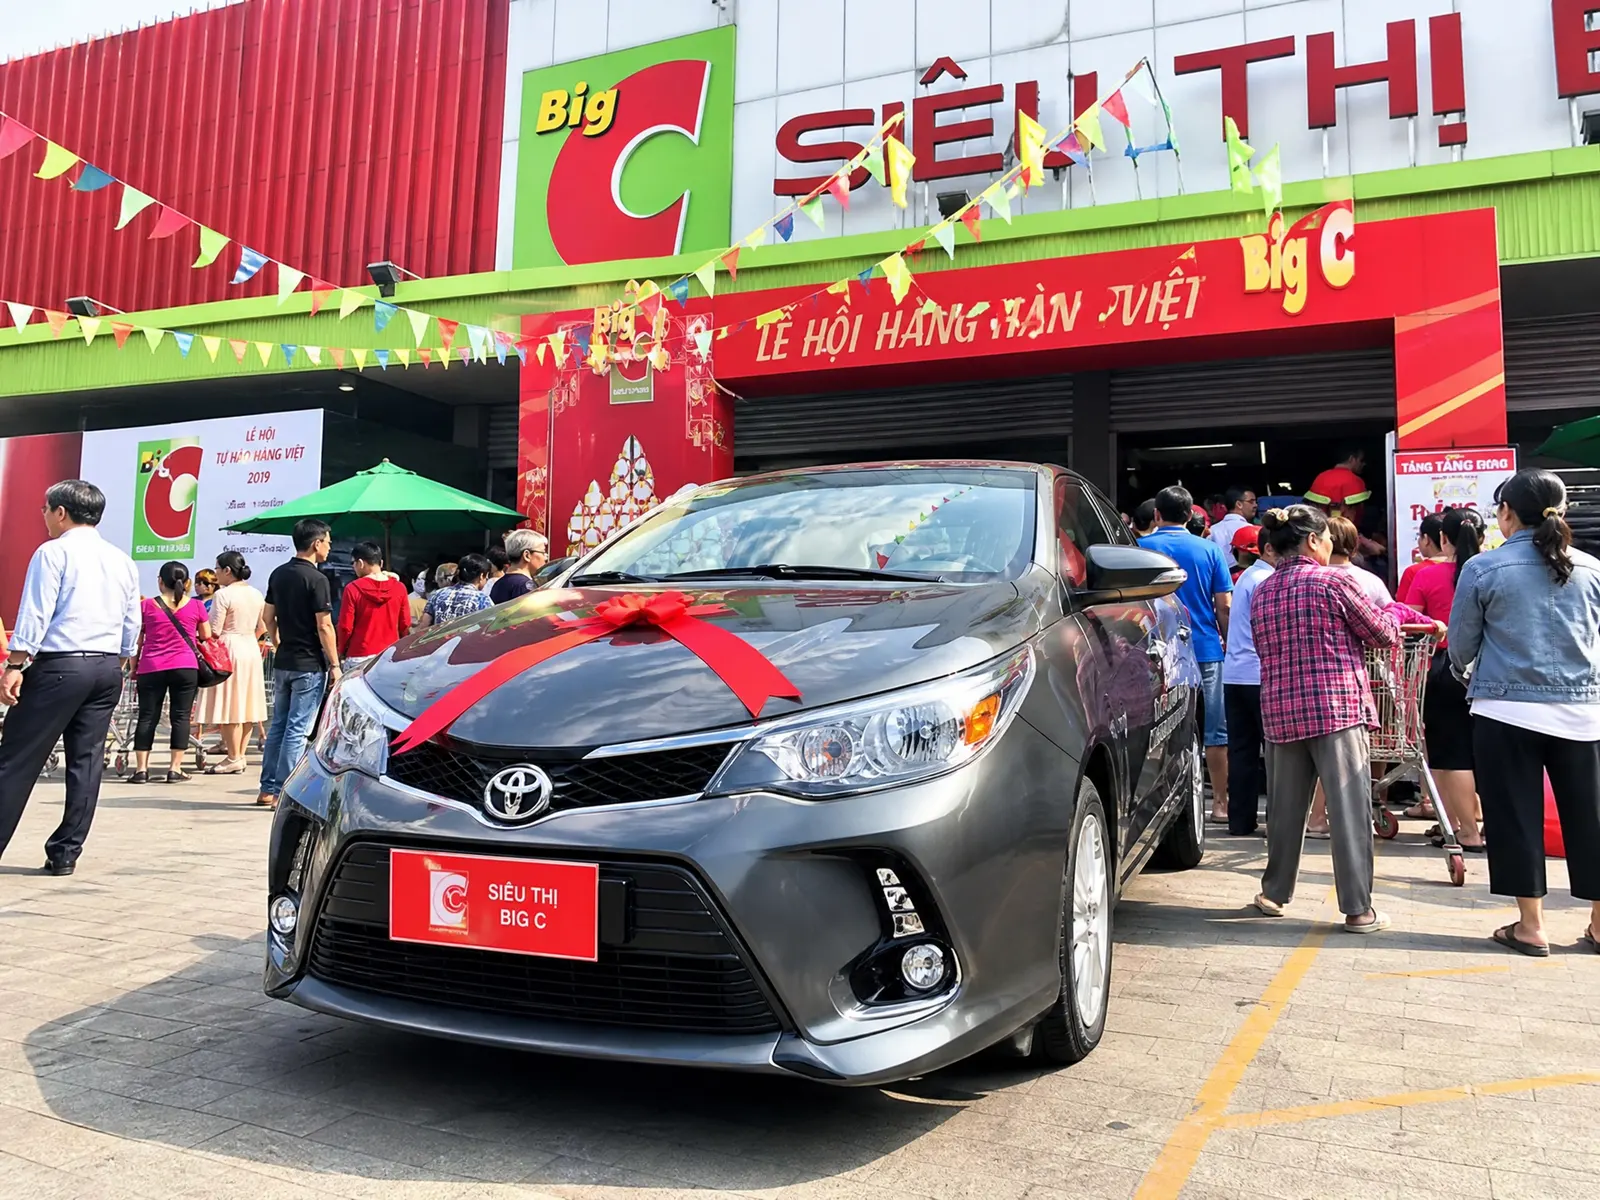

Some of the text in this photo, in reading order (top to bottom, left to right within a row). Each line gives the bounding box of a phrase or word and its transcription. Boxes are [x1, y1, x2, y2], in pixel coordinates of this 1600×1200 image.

[773, 56, 1098, 198] SIÊU
[1173, 12, 1469, 148] THỊ
[535, 59, 712, 266] Big C
[1240, 206, 1355, 315] Big C
[594, 299, 636, 342] Big
[801, 305, 863, 363] HỘI
[875, 296, 978, 351] HÀNG
[258, 426, 276, 443] HỘI
[285, 443, 305, 462] VIỆT
[247, 470, 271, 484] 2019
[488, 881, 558, 909] SIÊU THỊ
[500, 909, 547, 929] BIG C
